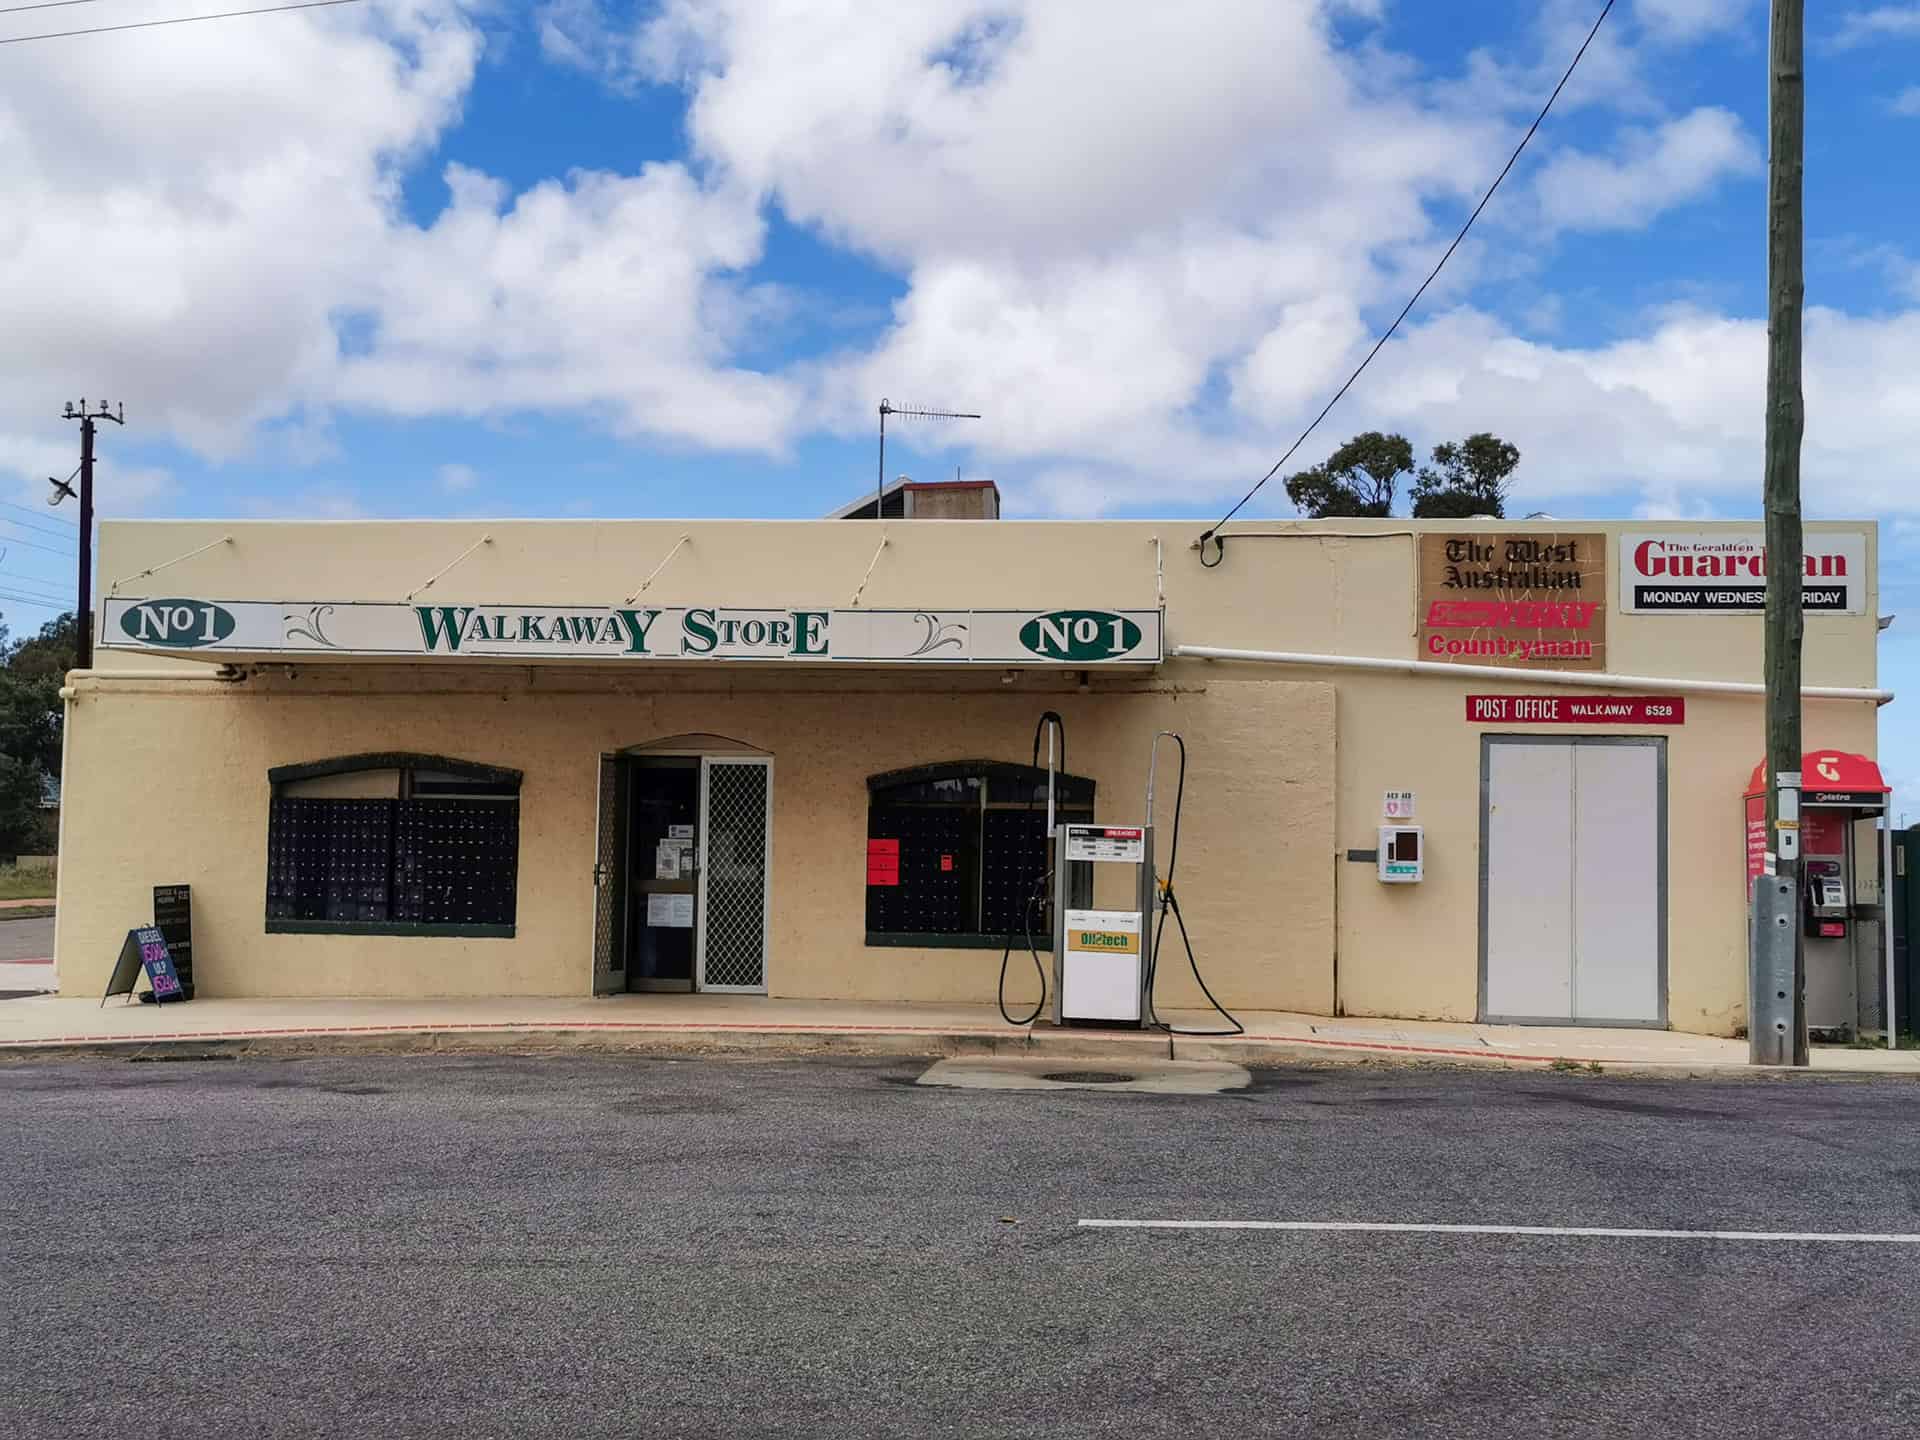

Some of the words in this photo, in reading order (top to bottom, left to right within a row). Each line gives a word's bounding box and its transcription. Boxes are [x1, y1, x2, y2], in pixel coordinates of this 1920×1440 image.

[1446, 540, 1495, 563] The
[1505, 540, 1577, 563] West
[1634, 539, 1848, 577] Guardan
[1667, 543, 1689, 552] The
[1442, 566, 1582, 590] Australian
[1643, 592, 1700, 603] MONDAY
[1801, 592, 1841, 604] RIDAY
[415, 606, 662, 655] WALKAWAY
[681, 608, 830, 656] STORE
[1428, 635, 1592, 660] Countryman
[1475, 699, 1507, 719] POST
[1515, 699, 1559, 719] OFFICE
[1570, 704, 1633, 715] WALKAWAY
[1645, 705, 1673, 716] 6528
